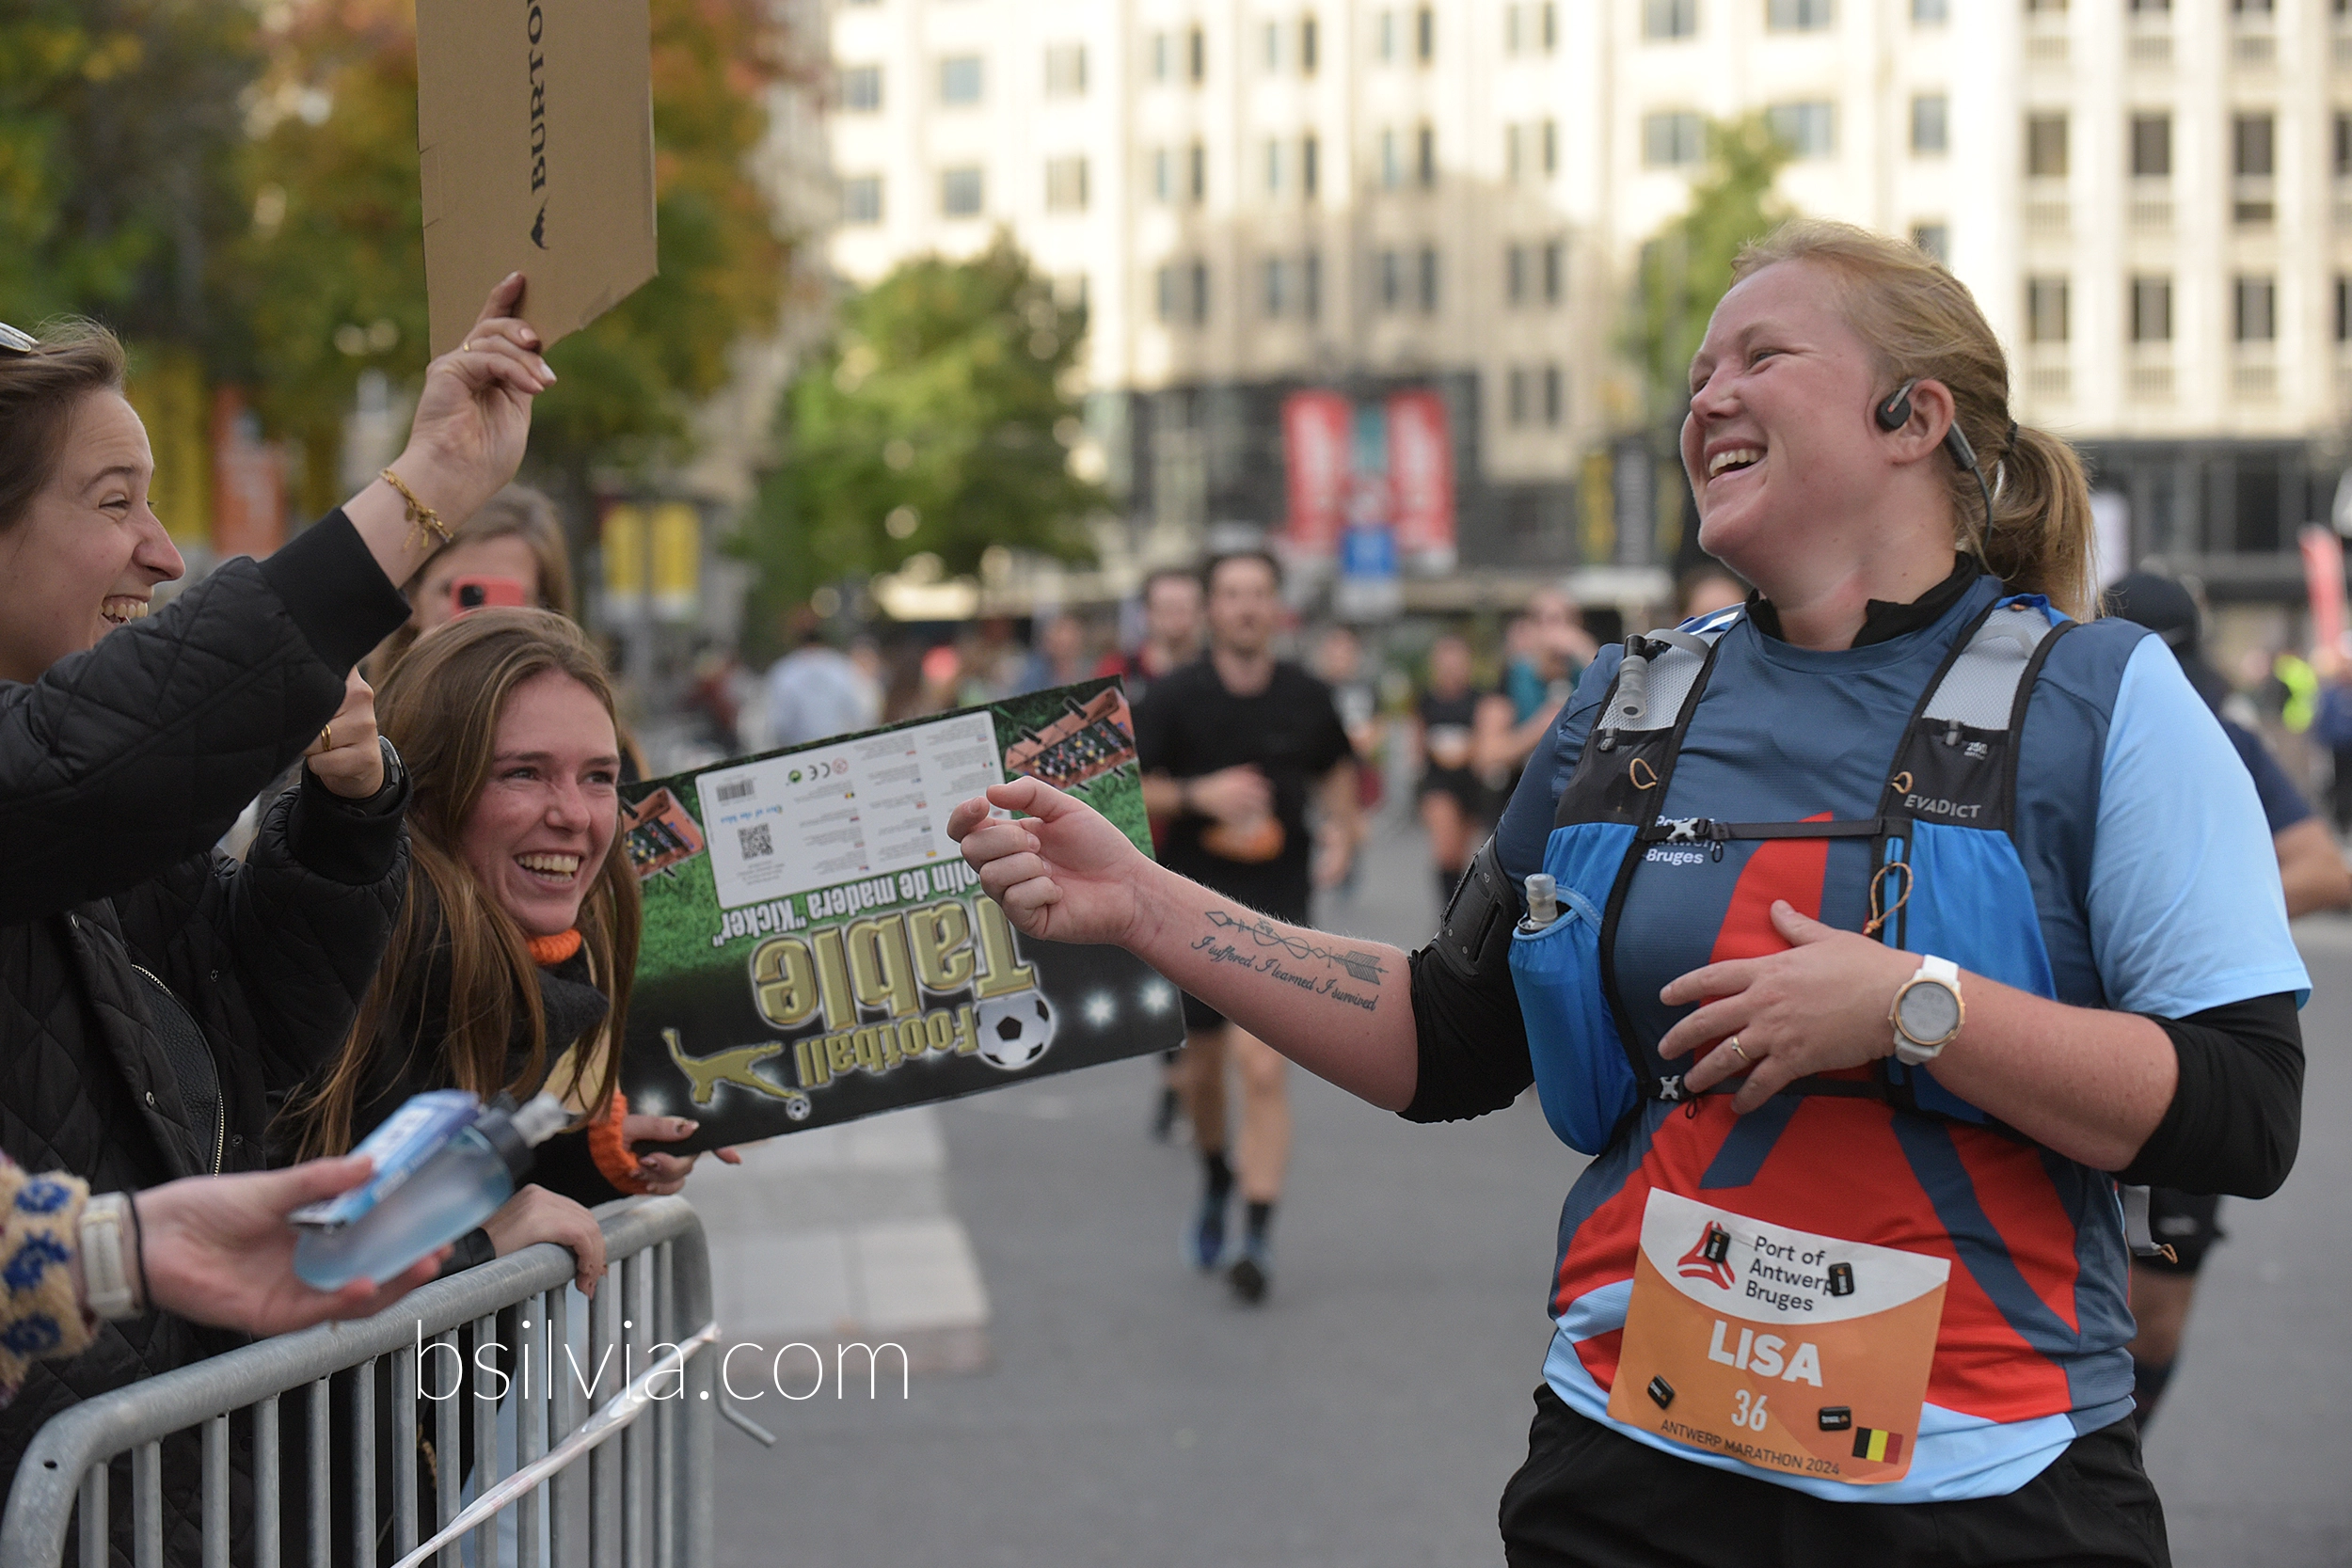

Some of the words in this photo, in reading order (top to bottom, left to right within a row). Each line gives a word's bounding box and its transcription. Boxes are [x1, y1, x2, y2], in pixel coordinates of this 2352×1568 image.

[528, 0, 546, 195] BURTO
[1903, 794, 1982, 818] EVADICT
[931, 860, 980, 895] olín
[1646, 848, 1704, 866] Bruges
[806, 876, 898, 920] madera
[898, 869, 930, 902] de
[754, 894, 1036, 1029] Table
[1208, 945, 1256, 968] suffered
[1271, 964, 1317, 990] learned
[1331, 988, 1379, 1011] survived
[795, 1005, 979, 1088] Football
[1754, 1235, 1796, 1261] Port
[1802, 1250, 1826, 1266] of
[1745, 1279, 1815, 1311] Bruges
[1708, 1319, 1823, 1387] LISA
[1730, 1388, 1769, 1432] 36
[1661, 1418, 1722, 1451] ANTWERP
[1724, 1436, 1803, 1469] MARATHON
[1805, 1459, 1840, 1475] 2024
